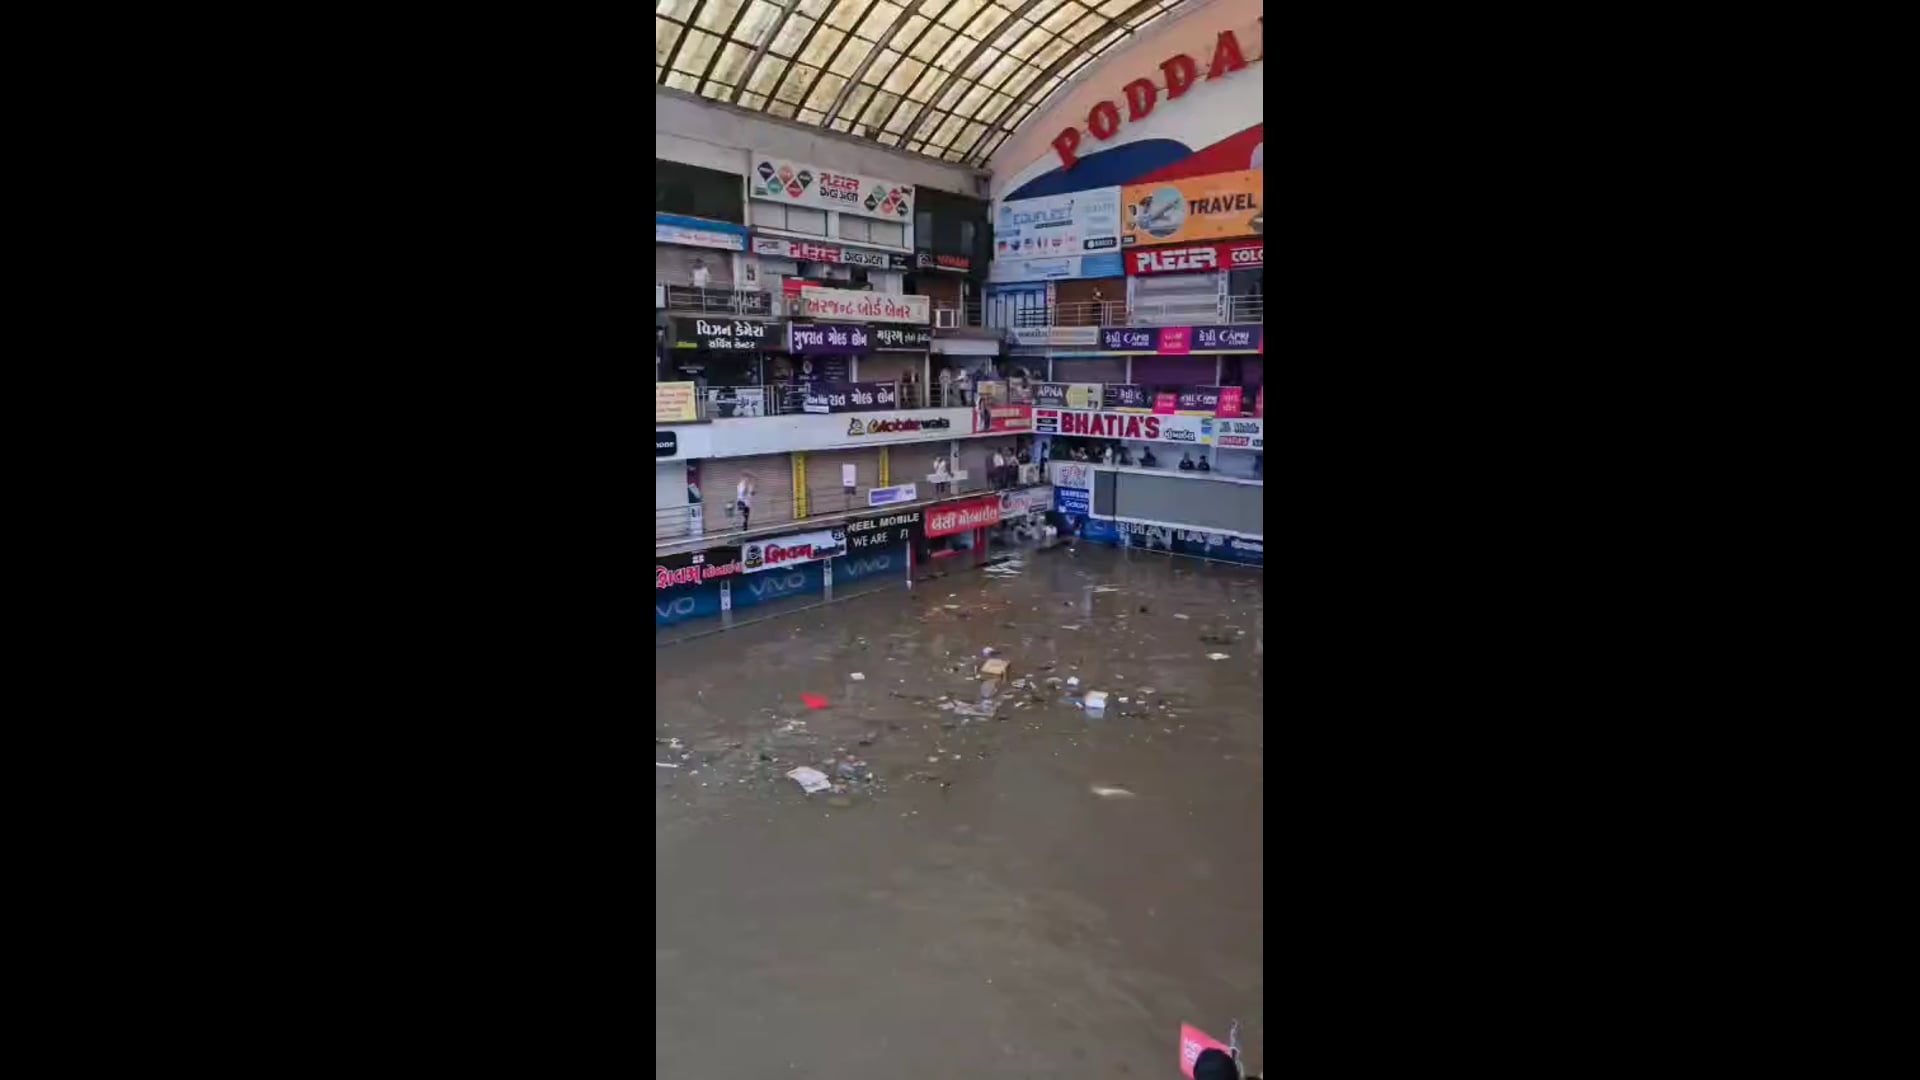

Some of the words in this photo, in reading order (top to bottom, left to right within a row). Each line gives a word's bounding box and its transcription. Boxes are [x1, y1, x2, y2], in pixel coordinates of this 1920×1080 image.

[1052, 16, 1263, 171] PODDA
[1189, 193, 1257, 216] TRAVEL
[1136, 247, 1217, 272] PLEZER
[794, 330, 823, 350] ગુજરાત
[828, 327, 847, 346] ગોલ્ડ
[851, 328, 868, 346] લોન
[1060, 411, 1160, 439] BHATIA'S
[880, 513, 920, 527] MOBILE
[853, 536, 868, 547] WE
[870, 532, 888, 545] ARE
